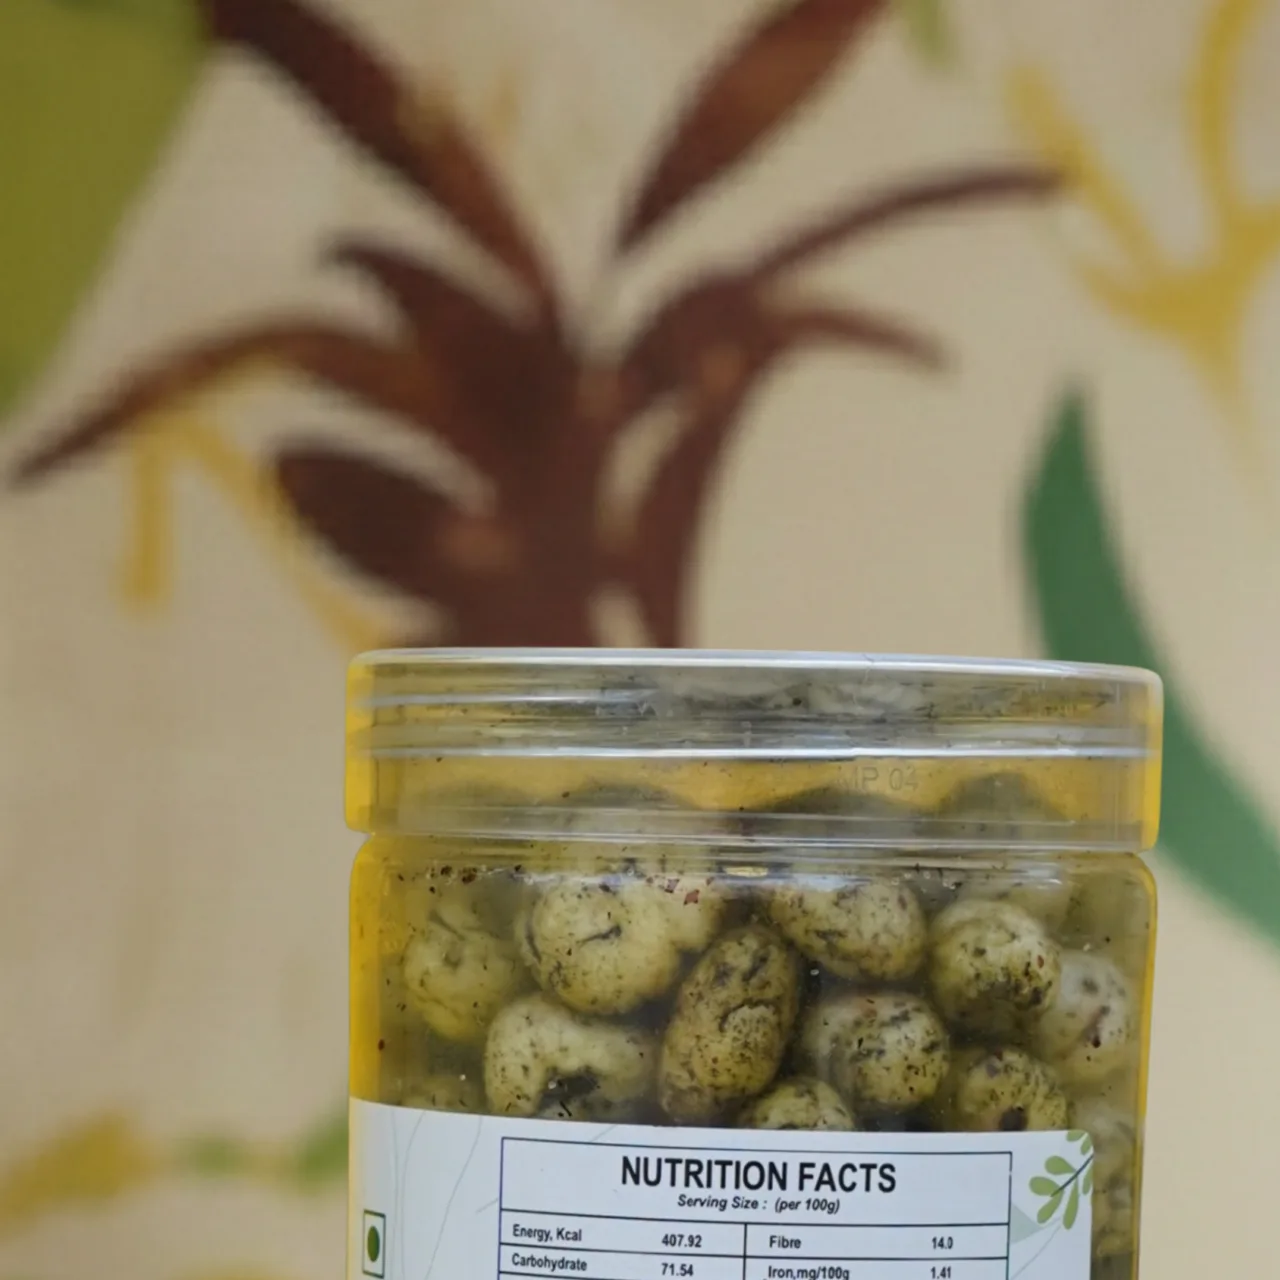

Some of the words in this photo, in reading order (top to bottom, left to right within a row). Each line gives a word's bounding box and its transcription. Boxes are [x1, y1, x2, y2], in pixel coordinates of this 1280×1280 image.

[621, 1155, 787, 1191] NUTRITION
[798, 1162, 896, 1193] FACTS
[677, 1193, 728, 1212] Serving
[731, 1195, 759, 1210] Size
[774, 1197, 801, 1213] (per
[805, 1198, 840, 1215] 100g)
[512, 1223, 553, 1243] Energy,
[556, 1227, 582, 1241] Kcal
[661, 1233, 702, 1248] 407.92
[769, 1235, 802, 1249] Fibre
[931, 1236, 953, 1249] 14.0
[511, 1252, 587, 1272] Carbohydrate
[661, 1262, 694, 1277] 71.54
[930, 1266, 951, 1279] 1.41
